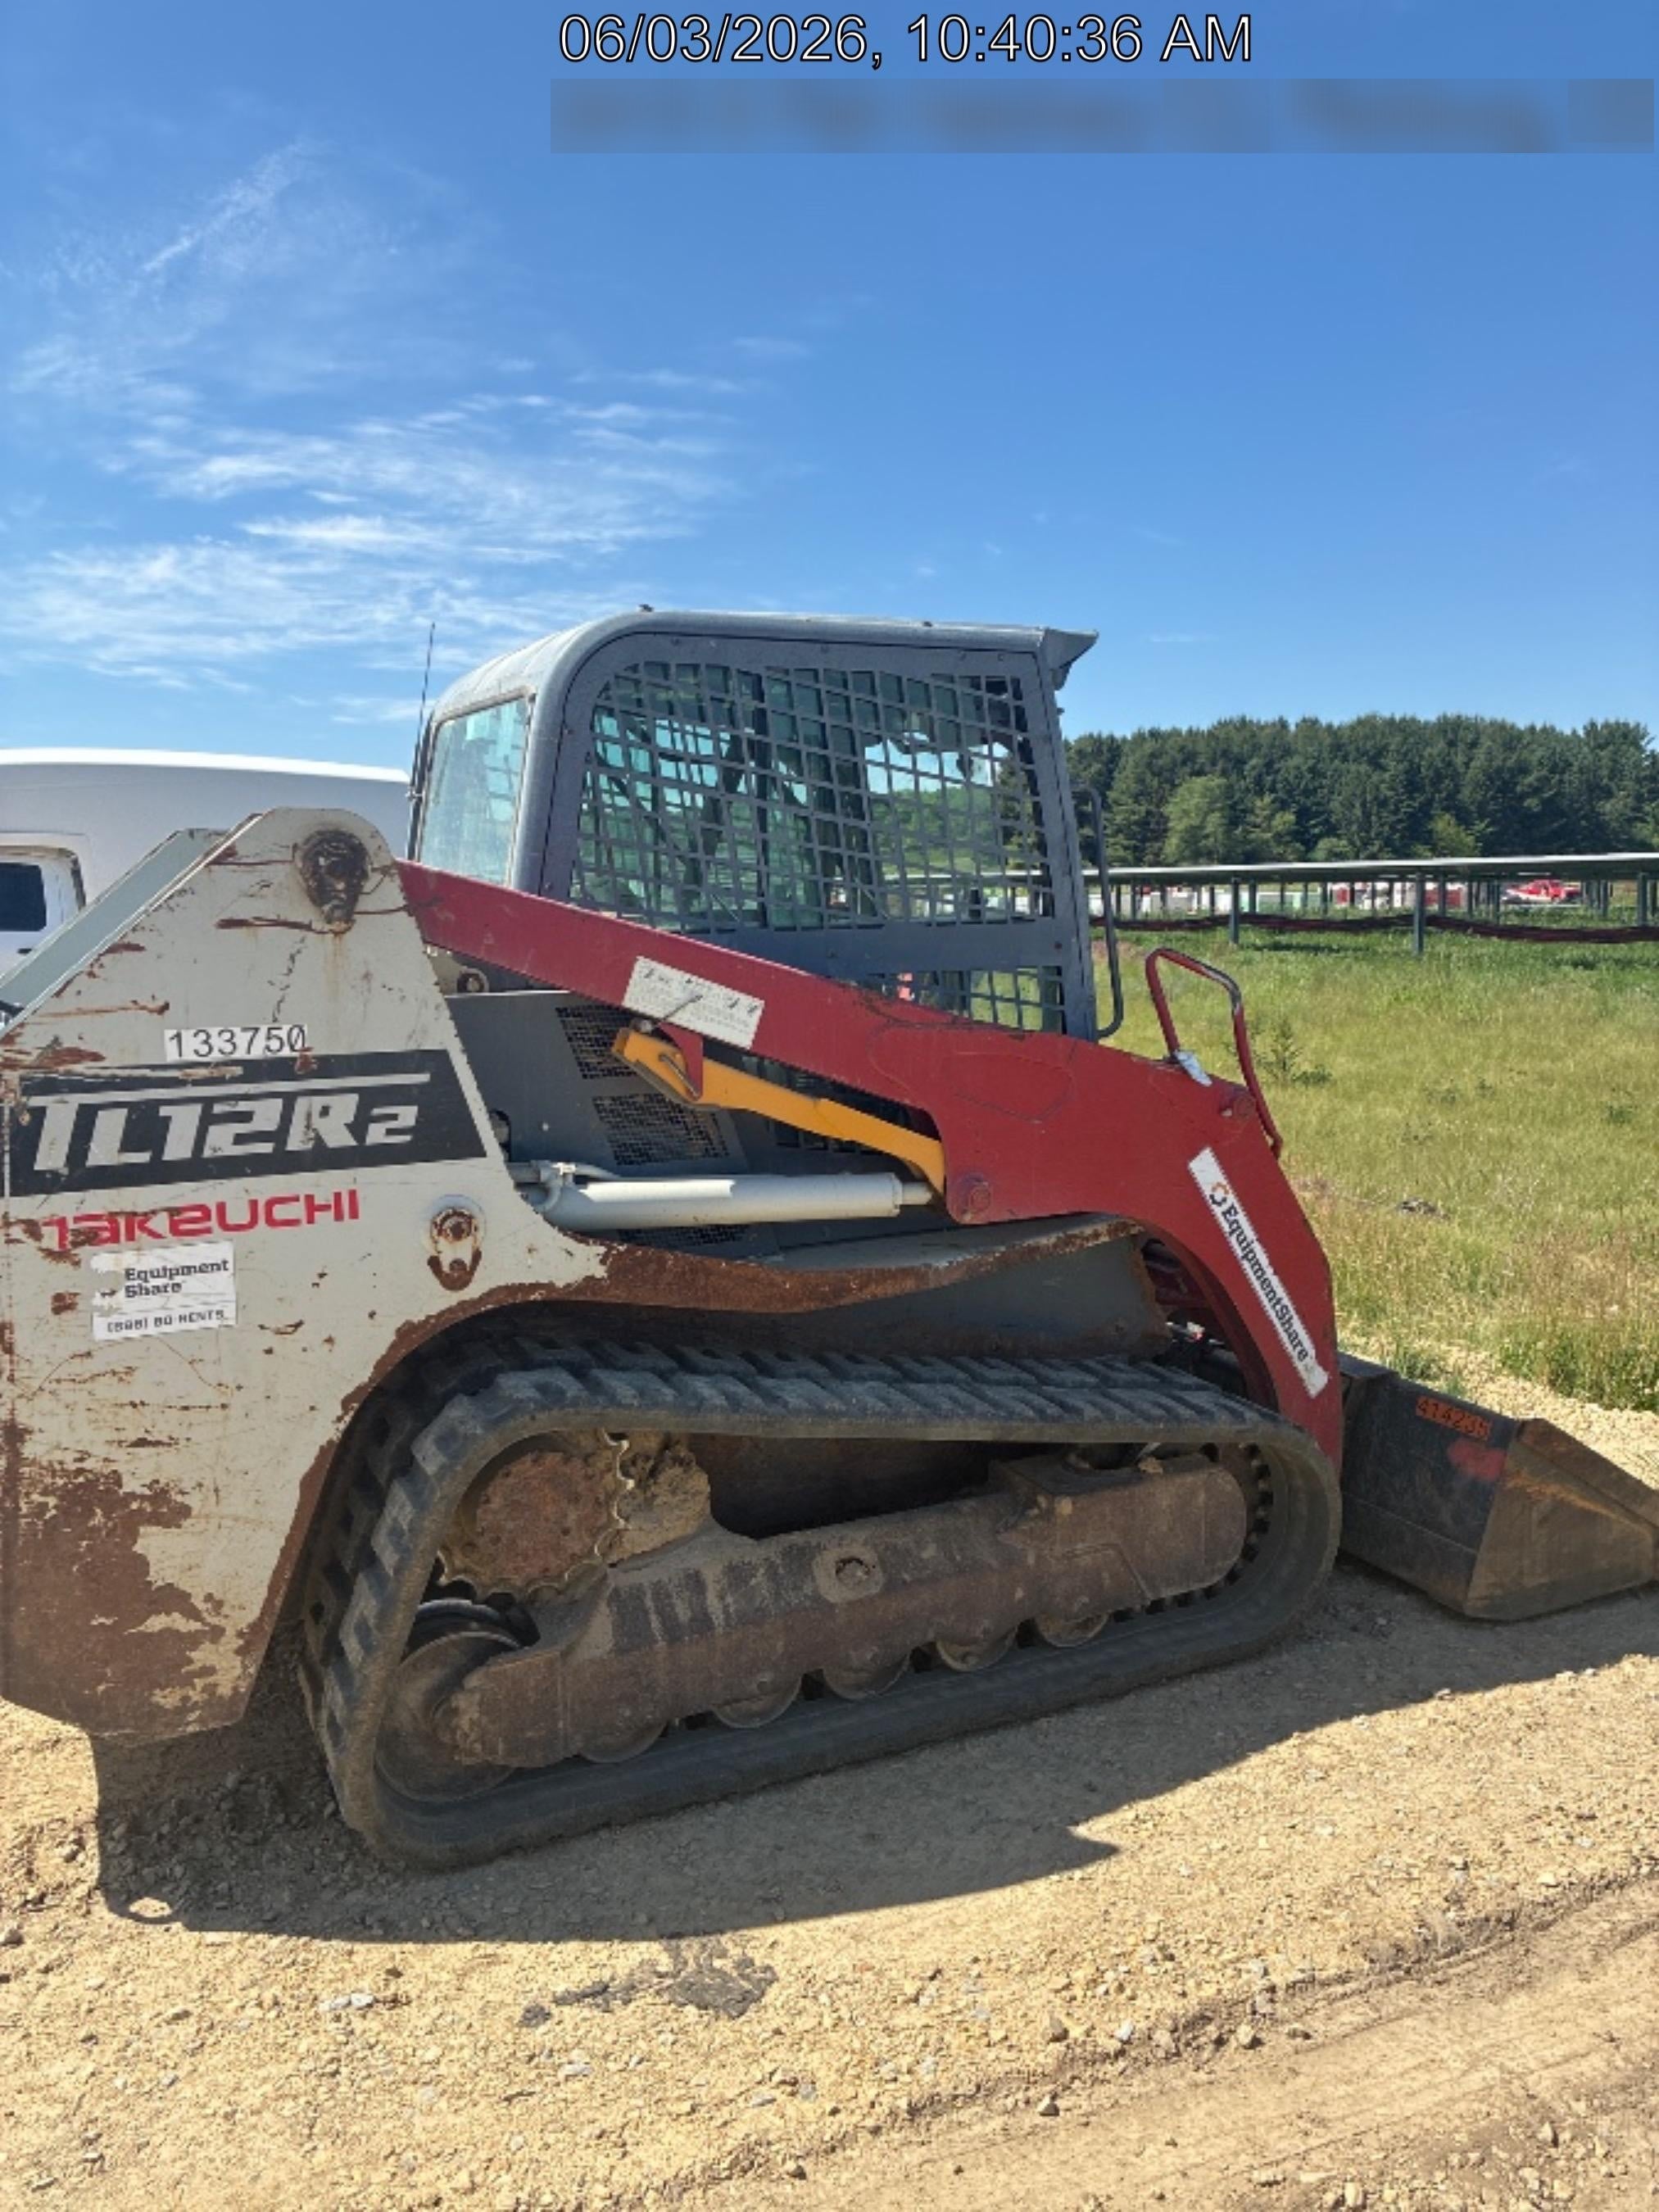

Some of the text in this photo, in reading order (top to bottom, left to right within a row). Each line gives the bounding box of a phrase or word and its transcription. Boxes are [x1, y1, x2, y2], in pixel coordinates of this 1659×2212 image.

[168, 1025, 306, 1058] 133750
[125, 1259, 229, 1284] Equipment
[1221, 1203, 1310, 1362] EquipmentShare
[125, 1282, 183, 1299] Share
